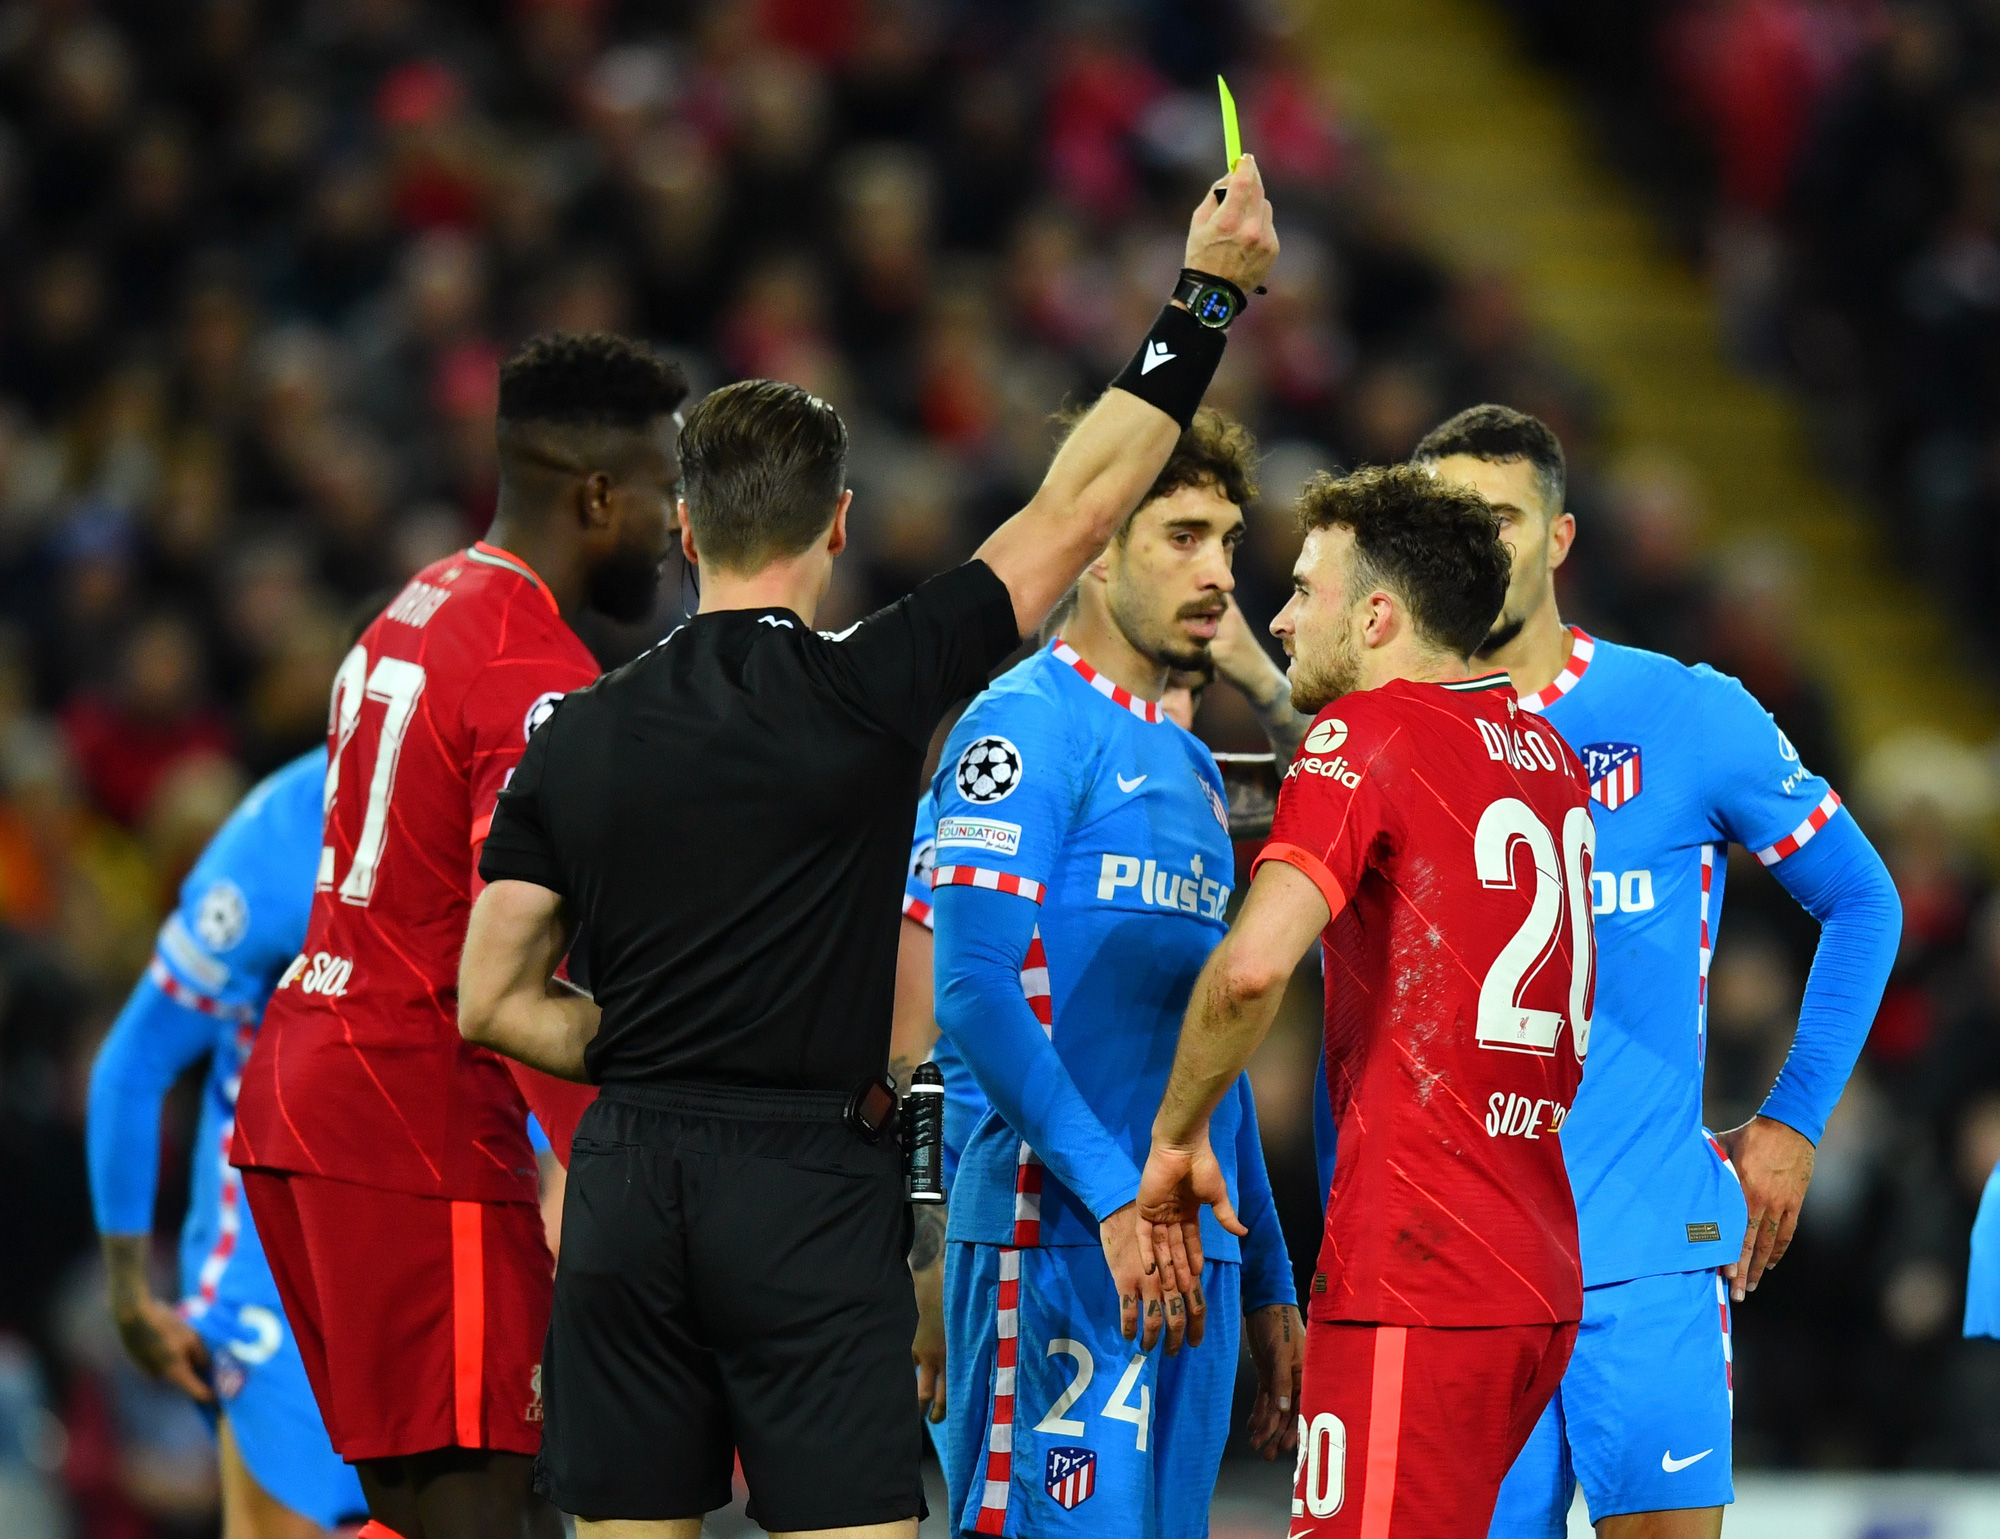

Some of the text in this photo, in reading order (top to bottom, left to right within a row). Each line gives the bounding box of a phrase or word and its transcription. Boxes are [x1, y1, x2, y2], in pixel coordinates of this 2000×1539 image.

[316, 644, 426, 907] 27
[1284, 756, 1361, 789] xpedia
[1097, 853, 1231, 921] Plus50
[1474, 797, 1597, 1065] 20
[1485, 1091, 1551, 1140] SIDE
[526, 1407, 544, 1421] LF
[1033, 1338, 1148, 1454] 24
